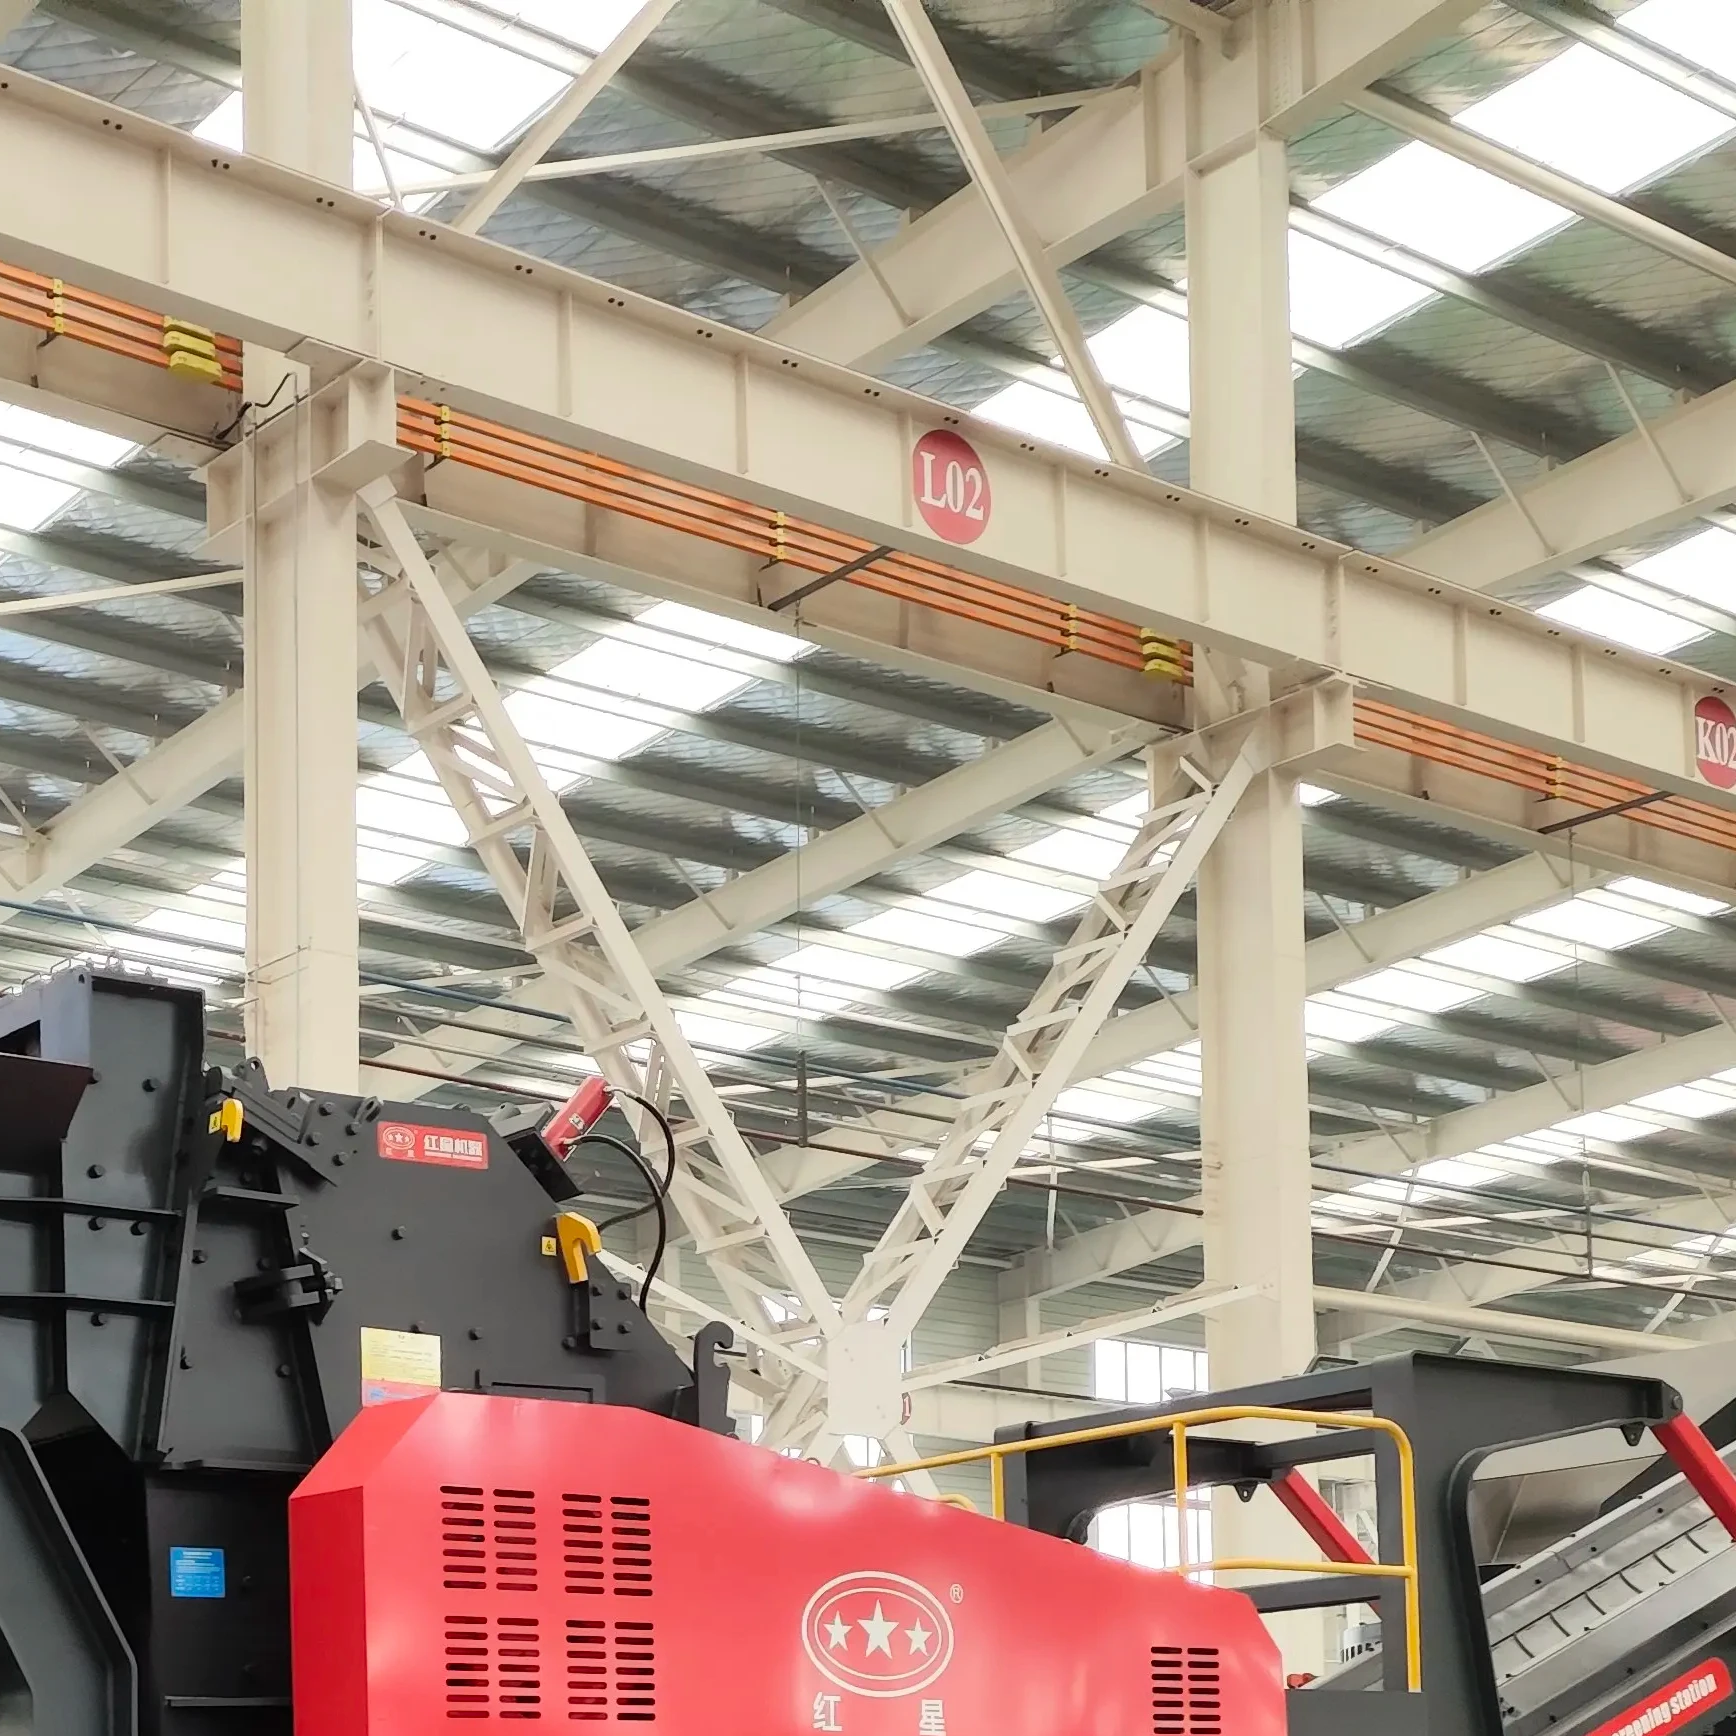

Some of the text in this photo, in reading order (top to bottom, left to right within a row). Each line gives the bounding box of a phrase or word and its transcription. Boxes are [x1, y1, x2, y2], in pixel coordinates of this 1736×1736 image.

[920, 451, 984, 521] L02
[1695, 716, 1736, 770] K02
[1669, 1673, 1717, 1715] station
